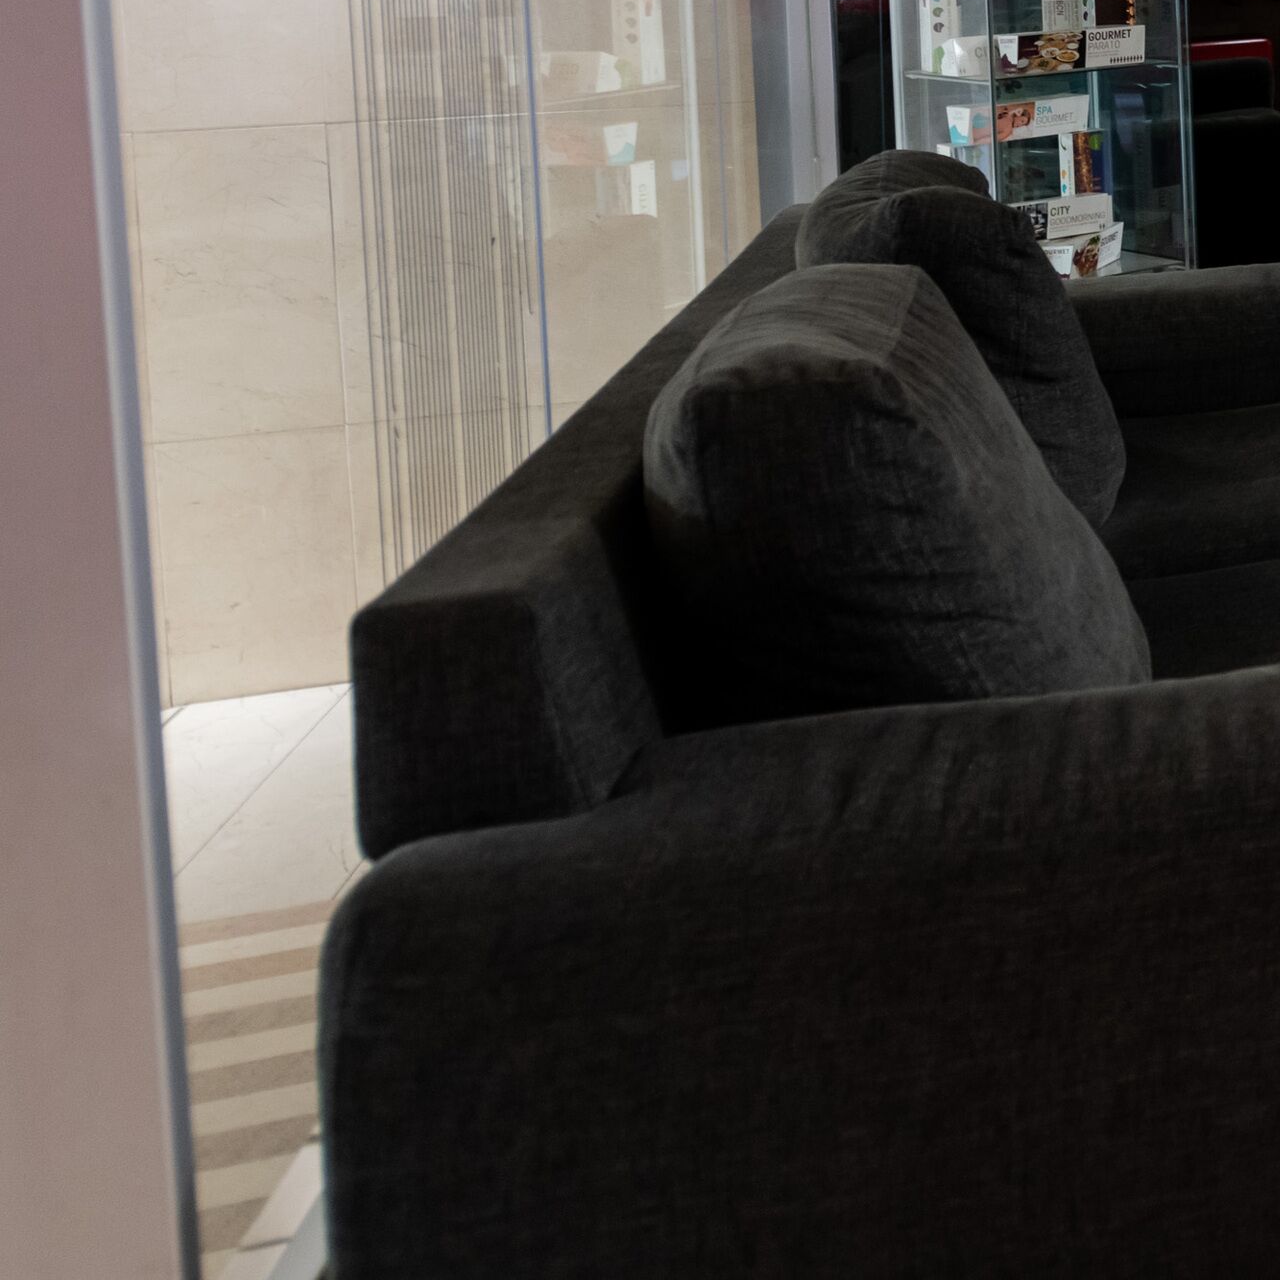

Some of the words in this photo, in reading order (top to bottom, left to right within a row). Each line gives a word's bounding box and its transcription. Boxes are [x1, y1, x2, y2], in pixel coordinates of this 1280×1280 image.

[1088, 28, 1131, 42] GOURMET
[1036, 105, 1053, 114] SPA
[1036, 112, 1074, 125] GOURMET
[1050, 205, 1071, 217] CITY
